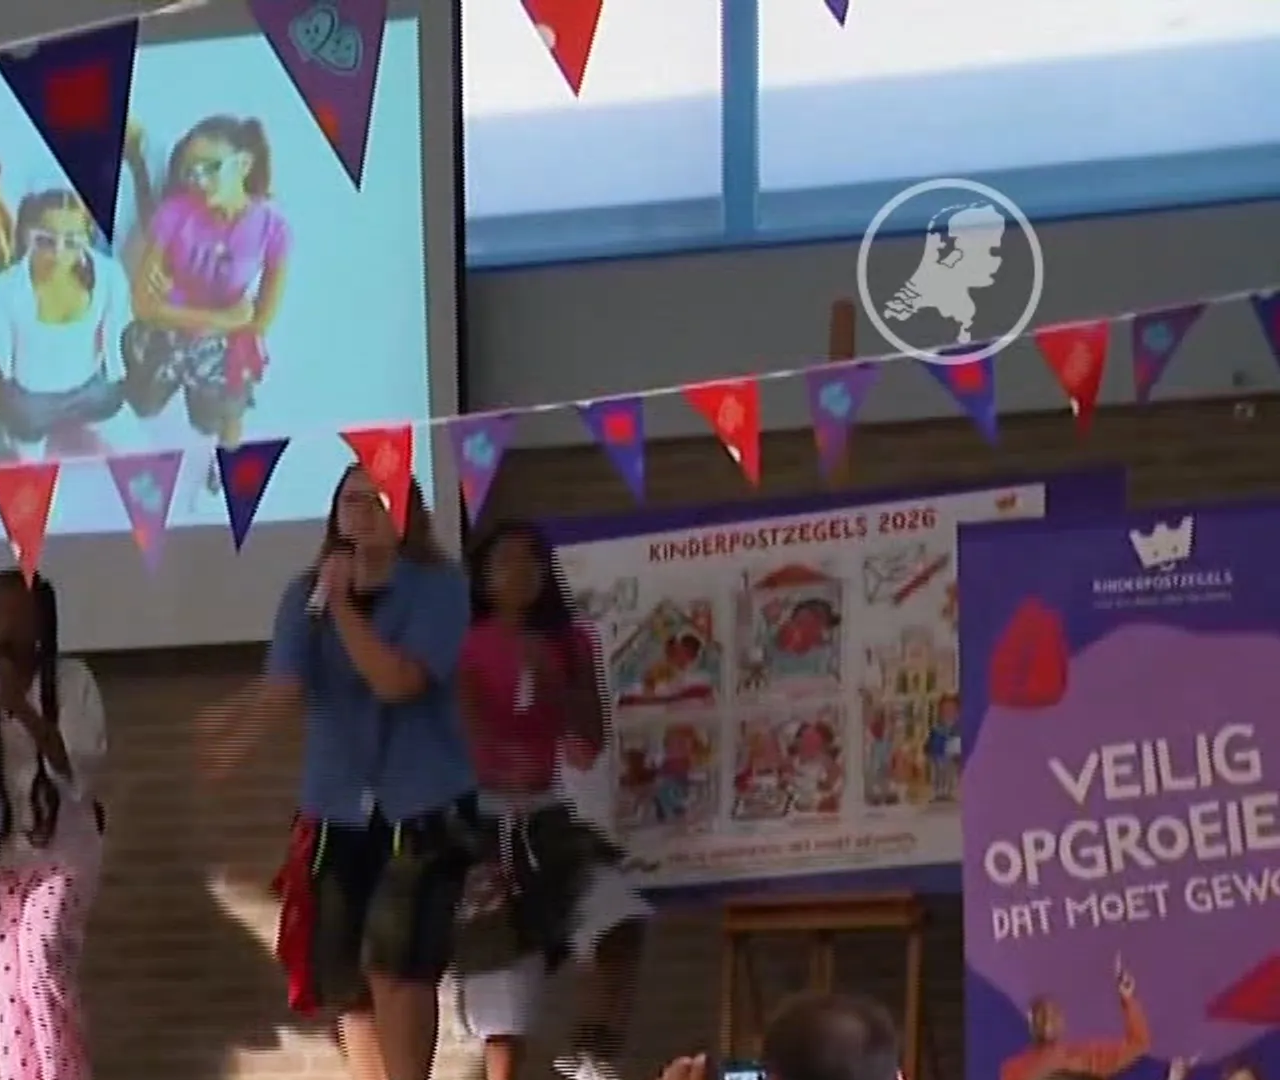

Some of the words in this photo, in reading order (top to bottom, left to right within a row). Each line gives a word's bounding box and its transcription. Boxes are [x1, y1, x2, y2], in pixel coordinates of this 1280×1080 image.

[649, 514, 867, 562] KINDERPOSTZEGELS
[878, 507, 937, 535] 2026
[1048, 723, 1263, 805] VEILIG
[984, 791, 1280, 889] OPGROEIE
[991, 893, 1054, 943] DAT
[1065, 880, 1171, 929] MOET
